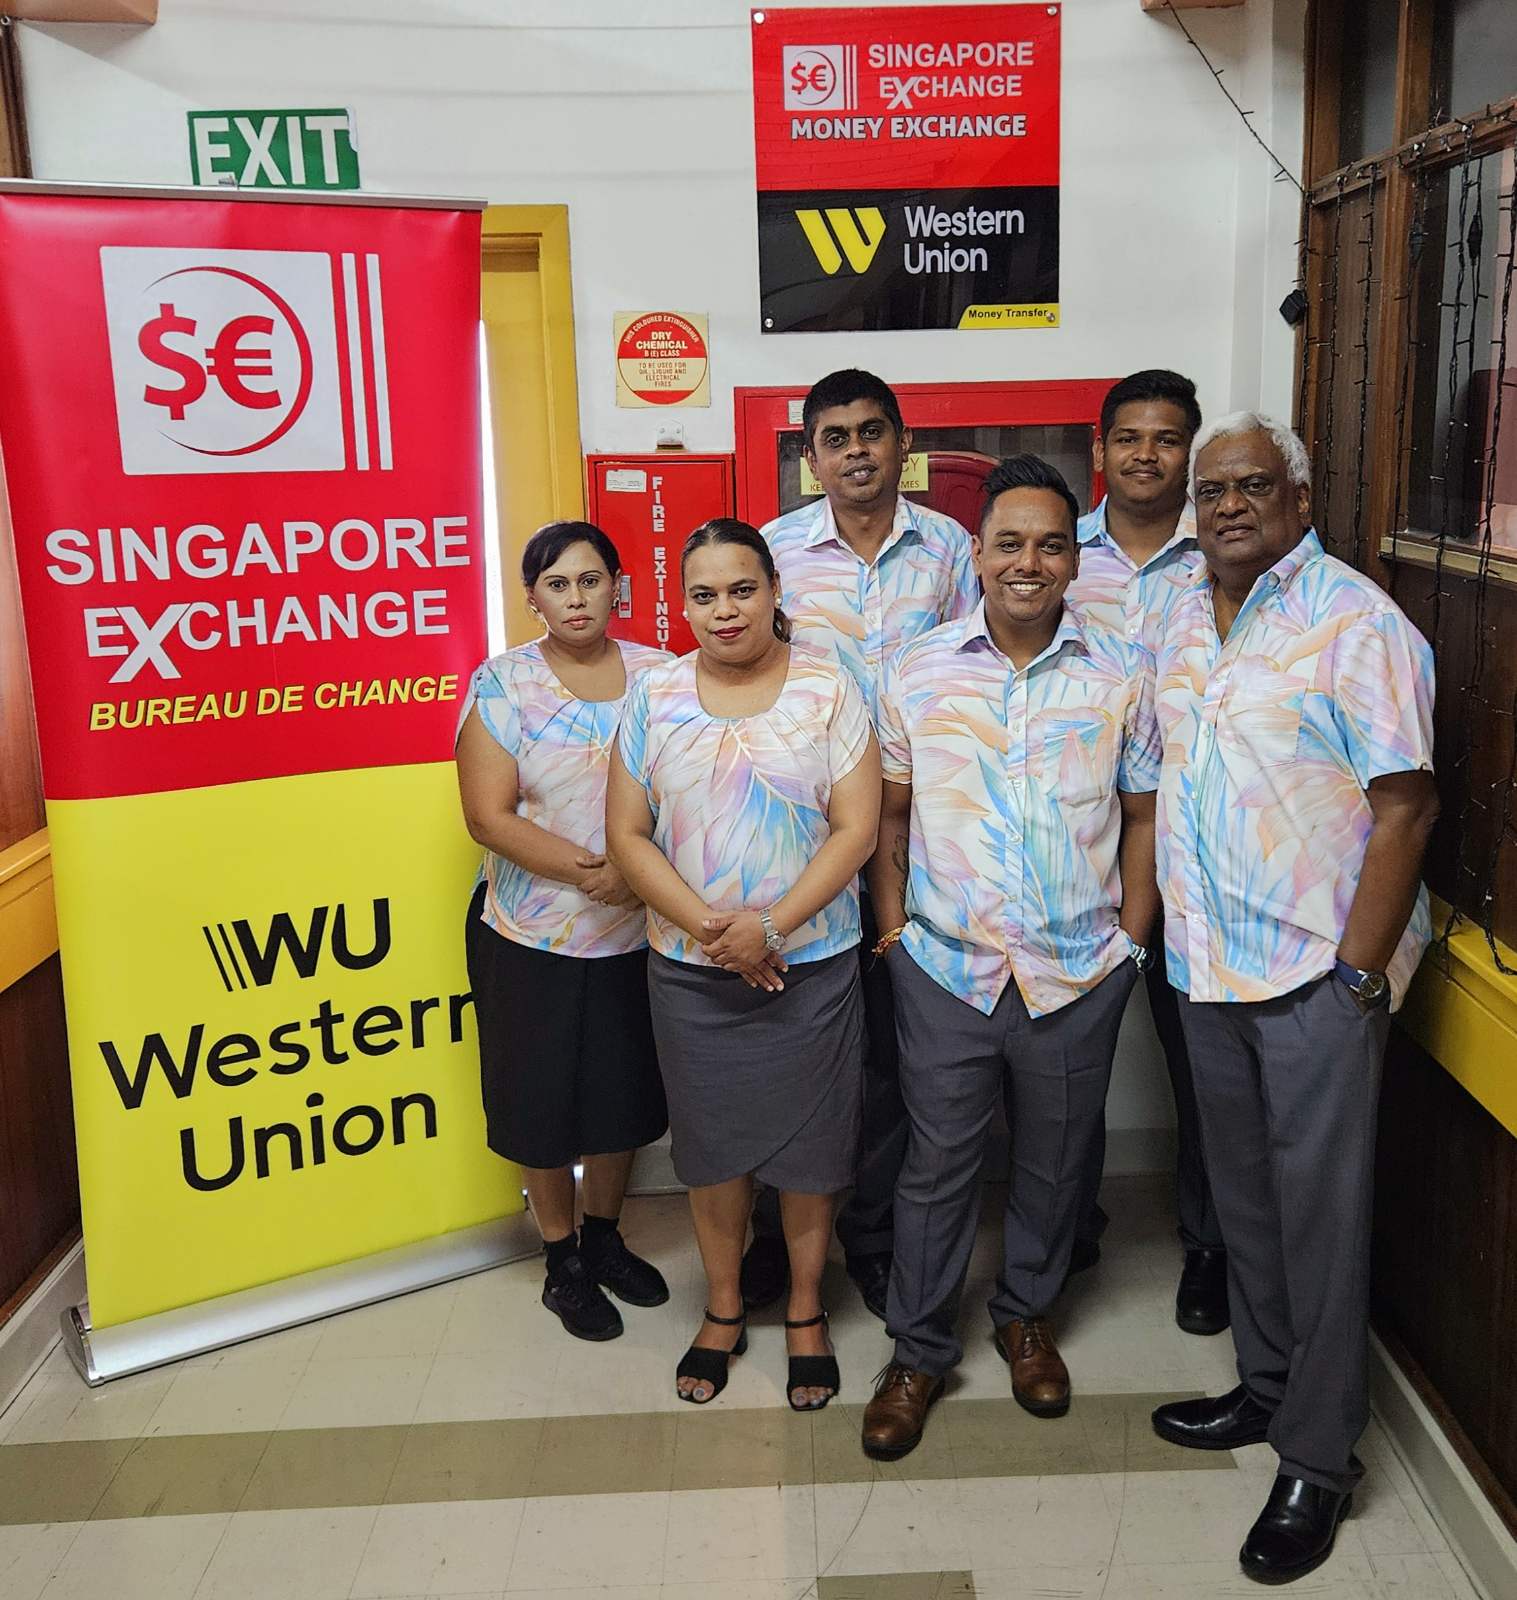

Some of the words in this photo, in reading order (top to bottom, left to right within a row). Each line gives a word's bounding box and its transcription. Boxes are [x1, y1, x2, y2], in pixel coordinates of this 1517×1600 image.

[867, 41, 1034, 68] SINGAPORE
[879, 75, 1022, 110] EXCHANGE
[791, 116, 883, 140] MONEY
[890, 115, 1027, 139] EXCHANGE
[193, 115, 349, 186] EXIT
[904, 206, 1025, 238] Western
[904, 243, 988, 274] Union
[624, 330, 635, 343] THIS
[632, 315, 662, 332] COLOURED
[968, 308, 1002, 319] Money
[1005, 308, 1047, 318] Transfer
[636, 341, 688, 349] CHEMICAL
[651, 331, 672, 340] DRY
[898, 480, 920, 489] MES
[651, 476, 665, 533] FIRE
[45, 515, 471, 586] SINGAPORE
[83, 589, 450, 684] EXCHANGE
[89, 690, 248, 731] BUREAU
[257, 685, 304, 715] DE
[313, 674, 459, 710] CHANGE
[230, 897, 391, 987] WU
[180, 1091, 438, 1192] Union
